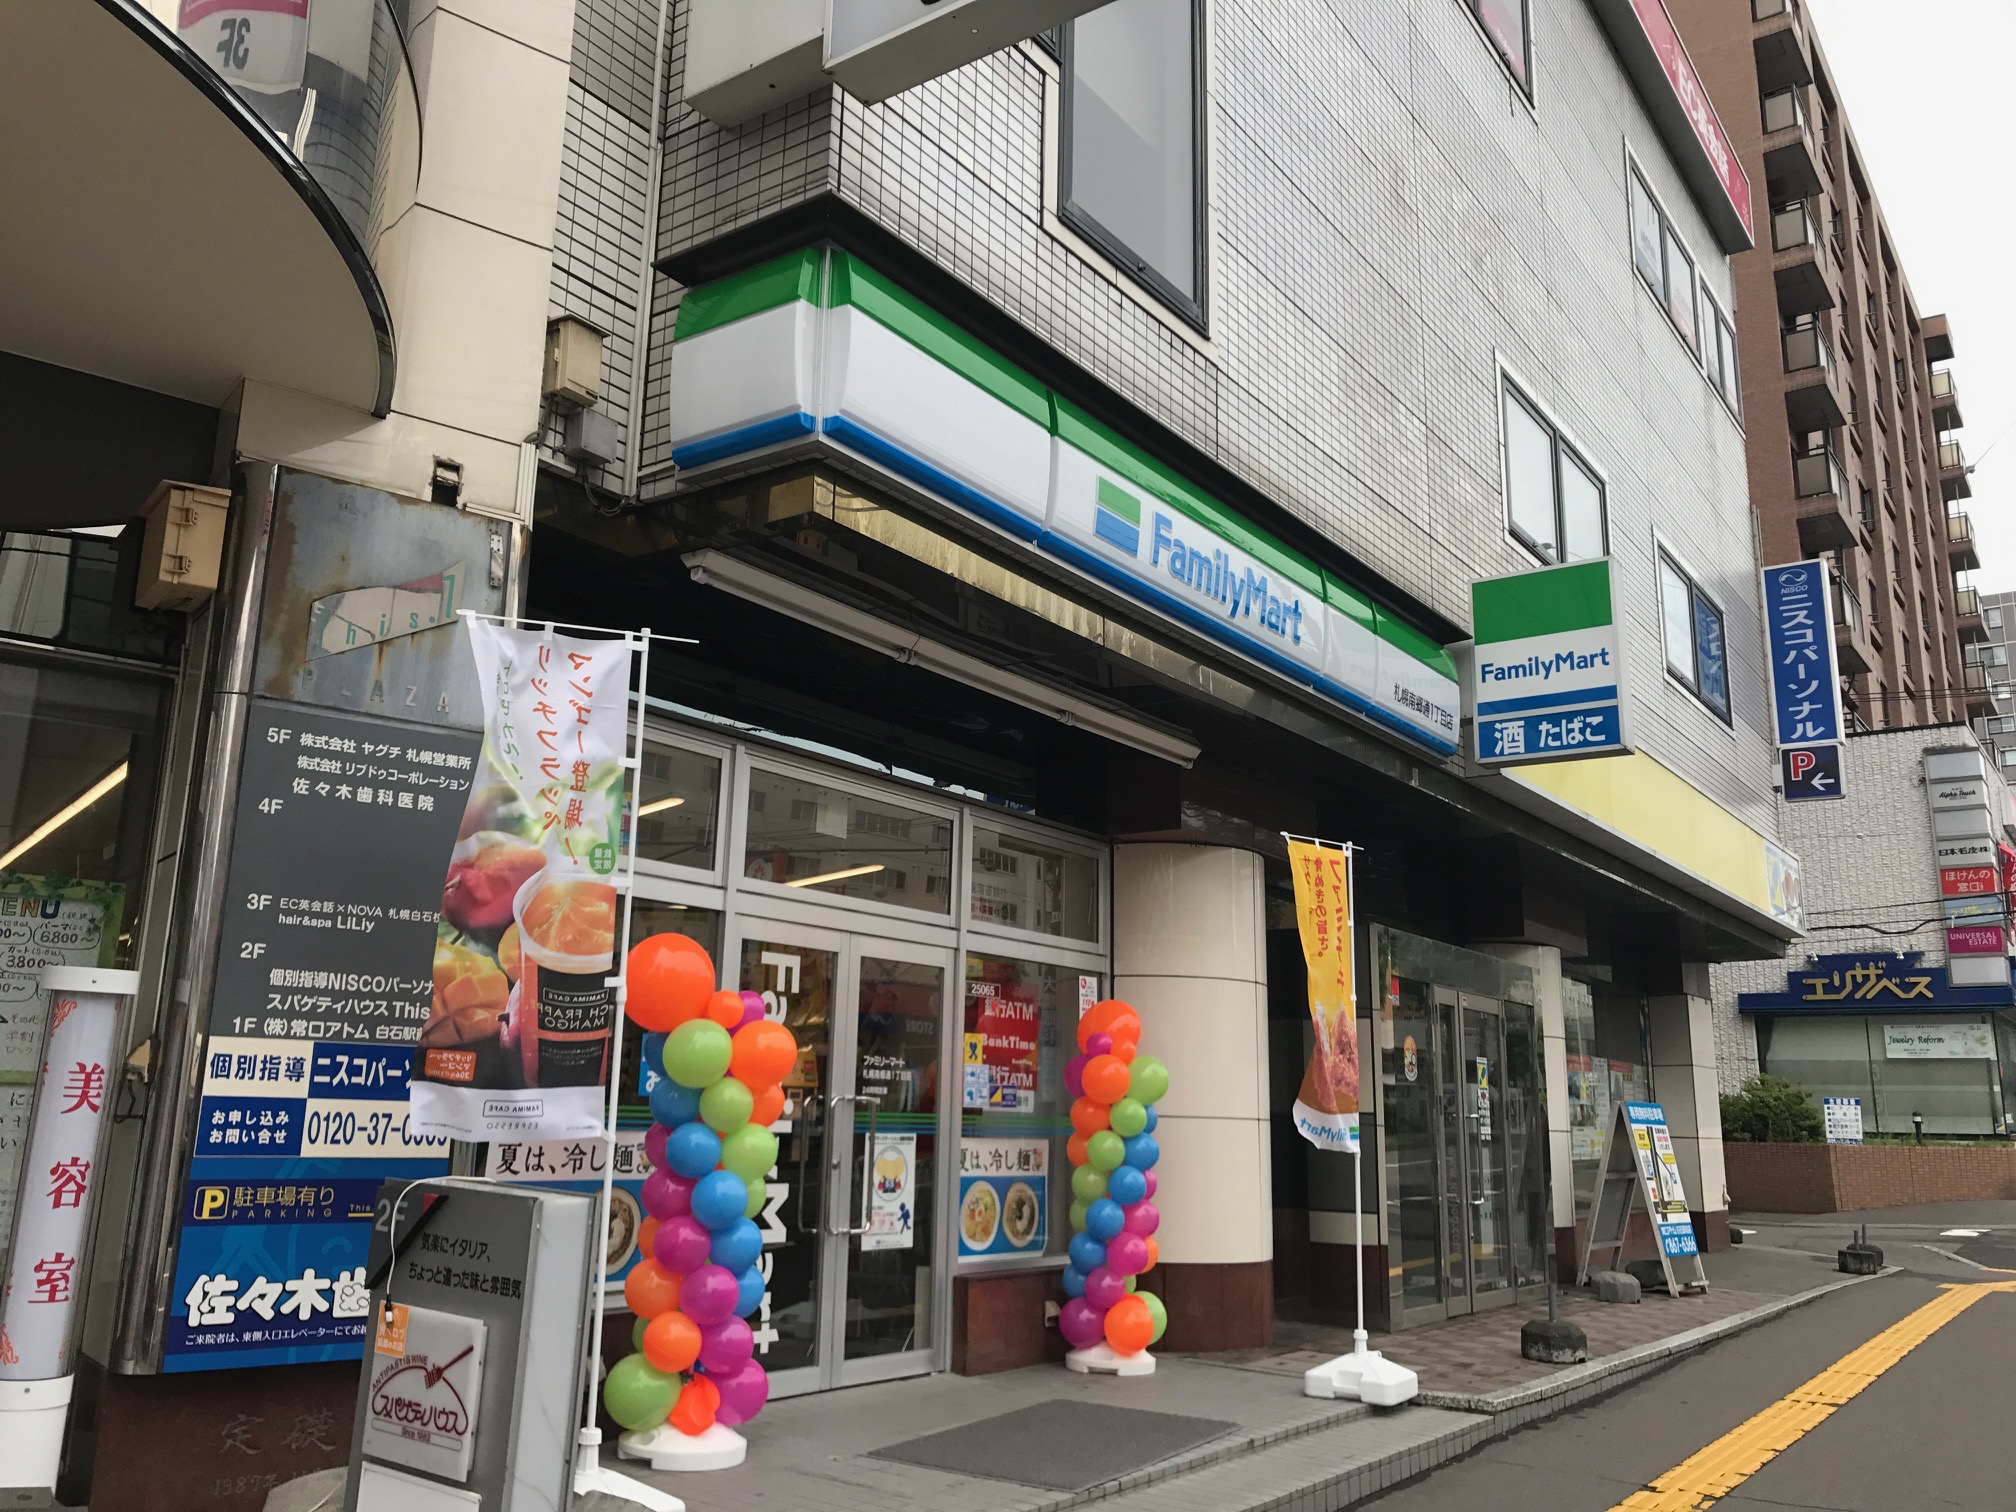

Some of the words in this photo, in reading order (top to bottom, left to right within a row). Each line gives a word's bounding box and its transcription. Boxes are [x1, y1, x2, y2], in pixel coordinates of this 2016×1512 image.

[1150, 510, 1303, 646] FamilyMart
[1781, 585, 1808, 595] NISCO
[1481, 647, 1610, 684] FamilyMart
[1779, 594, 1826, 740] ニスコパーソナル
[267, 727, 292, 744] 5F
[1494, 720, 1525, 756] 酒
[1538, 715, 1606, 749] たばこ
[300, 732, 357, 754] 株式会社
[362, 741, 402, 759] ヤグチ
[405, 748, 472, 770] 札幌営業所
[297, 755, 342, 775] 株式会社
[1789, 751, 1816, 781] P
[292, 777, 435, 812] 佐々木歯科医院
[258, 798, 284, 814] 4F
[1945, 870, 1990, 881] ほけんの
[1957, 881, 1979, 892] 窓口
[247, 893, 272, 911] 3F
[279, 912, 332, 929] hair&spa
[1950, 931, 1997, 941] UNIVERSAL
[1969, 938, 1997, 946] ESTATE
[240, 942, 267, 959] 2F
[971, 983, 995, 996] 25065
[1802, 962, 1934, 1000] エリザベス
[266, 993, 389, 1017] スパゲティハウス
[392, 1001, 430, 1020] This
[232, 1017, 257, 1034] 1F
[1887, 1035, 1914, 1046] Jewelry
[1917, 1035, 1945, 1045] Reform
[210, 1052, 306, 1082] 個別指導
[863, 1055, 905, 1067] ファミリーマート
[211, 1110, 290, 1128] お申し込み
[209, 1129, 287, 1145] お問い合せ
[28, 1062, 104, 1304] 美容室
[203, 1188, 225, 1219] P
[233, 1186, 335, 1207] 駐車場有り
[232, 1208, 332, 1219] PARKING
[375, 1198, 408, 1233] 2F
[420, 1232, 491, 1263] 気楽にイタリア、
[408, 1260, 522, 1300] ちょっと違った味と雰囲気
